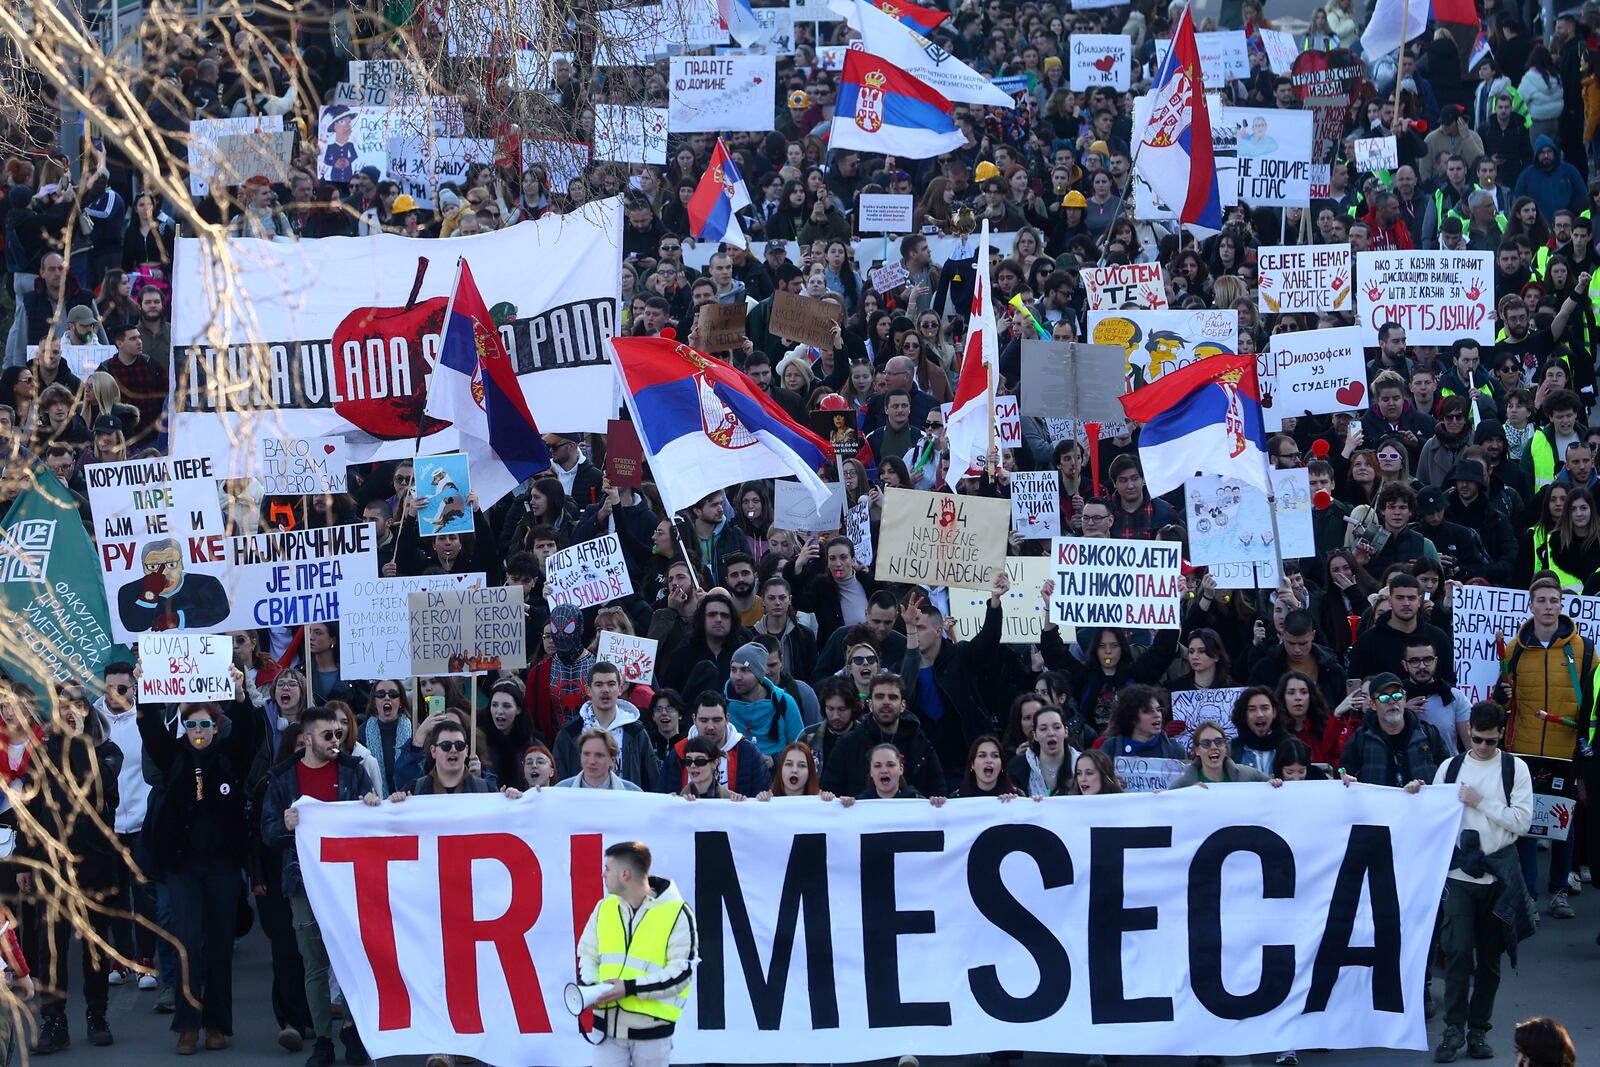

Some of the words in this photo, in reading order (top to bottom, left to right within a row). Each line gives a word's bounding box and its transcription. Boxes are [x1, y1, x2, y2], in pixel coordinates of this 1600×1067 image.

[684, 60, 734, 77] ПАДАТЕ
[687, 77, 726, 91] ДОМИНЕ
[1259, 159, 1310, 181] ДОПИРЕ
[1252, 178, 1286, 199] ГЛАС
[1259, 252, 1306, 270] СЕЈЕТЕ
[1312, 250, 1350, 268] НЕМАР
[1374, 258, 1391, 271] АКО
[1395, 258, 1404, 270] ЈЕ
[1410, 257, 1436, 271] КАЗНА
[1440, 257, 1451, 270] ЗА
[1452, 257, 1484, 272] ГРАФИТ
[1094, 264, 1161, 287] СИСТЕМ
[1282, 268, 1328, 289] ЖАЊЕТЕ
[1381, 271, 1429, 285] ДИСЛОКАЦИЈА
[1103, 285, 1138, 304] ТЕ
[1279, 289, 1331, 309] ГУБИТКЕ
[1388, 286, 1406, 300] ШТА
[1408, 286, 1417, 300] ЈЕ
[1419, 286, 1445, 299] КАЗНА
[1450, 286, 1460, 299] ЗА
[1371, 303, 1415, 332] СМРТ
[1417, 304, 1436, 332] 15
[1436, 303, 1486, 332] ЉУДИ?
[300, 336, 413, 405] VLADA
[529, 301, 615, 368] PADA
[1278, 347, 1352, 369] Филозофски
[1312, 365, 1325, 376] УЗ
[1292, 377, 1349, 393] СТУДЕНТЕ
[88, 462, 171, 488] КОРУПЦИЈА
[173, 457, 213, 481] ПЕРЕ
[264, 459, 286, 475] TU
[1041, 472, 1053, 480] ДА
[265, 476, 315, 494] DOBRO
[320, 474, 347, 493] SAM
[1011, 480, 1058, 494] КУПИМ
[132, 487, 175, 511] ПАРЕ
[1016, 500, 1055, 514] УЧИМ
[1017, 493, 1037, 501] ХОЋУ
[1042, 493, 1053, 501] ДА
[105, 516, 134, 538] АЛИ
[145, 514, 169, 535] НЕ
[190, 510, 205, 531] И
[233, 524, 370, 566] НАЈМРАЧНИЈЕ
[912, 526, 977, 547] NADLEŽNE
[102, 542, 136, 572] РУ
[188, 534, 226, 564] КЕ
[576, 535, 618, 565] AFRAID
[905, 541, 980, 562] INSTITUCIJE
[1058, 543, 1079, 566] КО
[1079, 544, 1136, 567] ВИСОКО
[1136, 547, 1178, 569] ЛЕТИ
[265, 566, 291, 594] ЈЕ
[295, 560, 344, 591] ПРЕД
[888, 555, 930, 580] NISU
[935, 562, 993, 584] NAĐENE
[401, 580, 421, 593] MY
[572, 579, 610, 608] SHOULD
[1057, 571, 1086, 596] ТАЈ
[1089, 572, 1134, 598] НИСКО
[1135, 574, 1178, 598] ПАДА
[427, 592, 445, 608] DA
[55, 581, 112, 652] ФАКУЛТЕТ
[344, 610, 411, 626] TOMORROW
[410, 610, 462, 626] KEROVI
[475, 605, 523, 622] KEROVI
[1055, 601, 1085, 623] ЧАК
[1087, 602, 1123, 624] ИАКО
[1125, 603, 1176, 625] ВЛАДА
[35, 592, 101, 668] ДРАМСКИХ
[411, 626, 462, 643] KEROVI
[474, 622, 523, 640] KEROVI
[199, 636, 215, 655] SE
[413, 643, 463, 660] KEROVI
[474, 639, 522, 657] KEROVI
[632, 640, 641, 649] U
[143, 677, 186, 696] MIRNOG
[694, 824, 1404, 1030] MESECA
